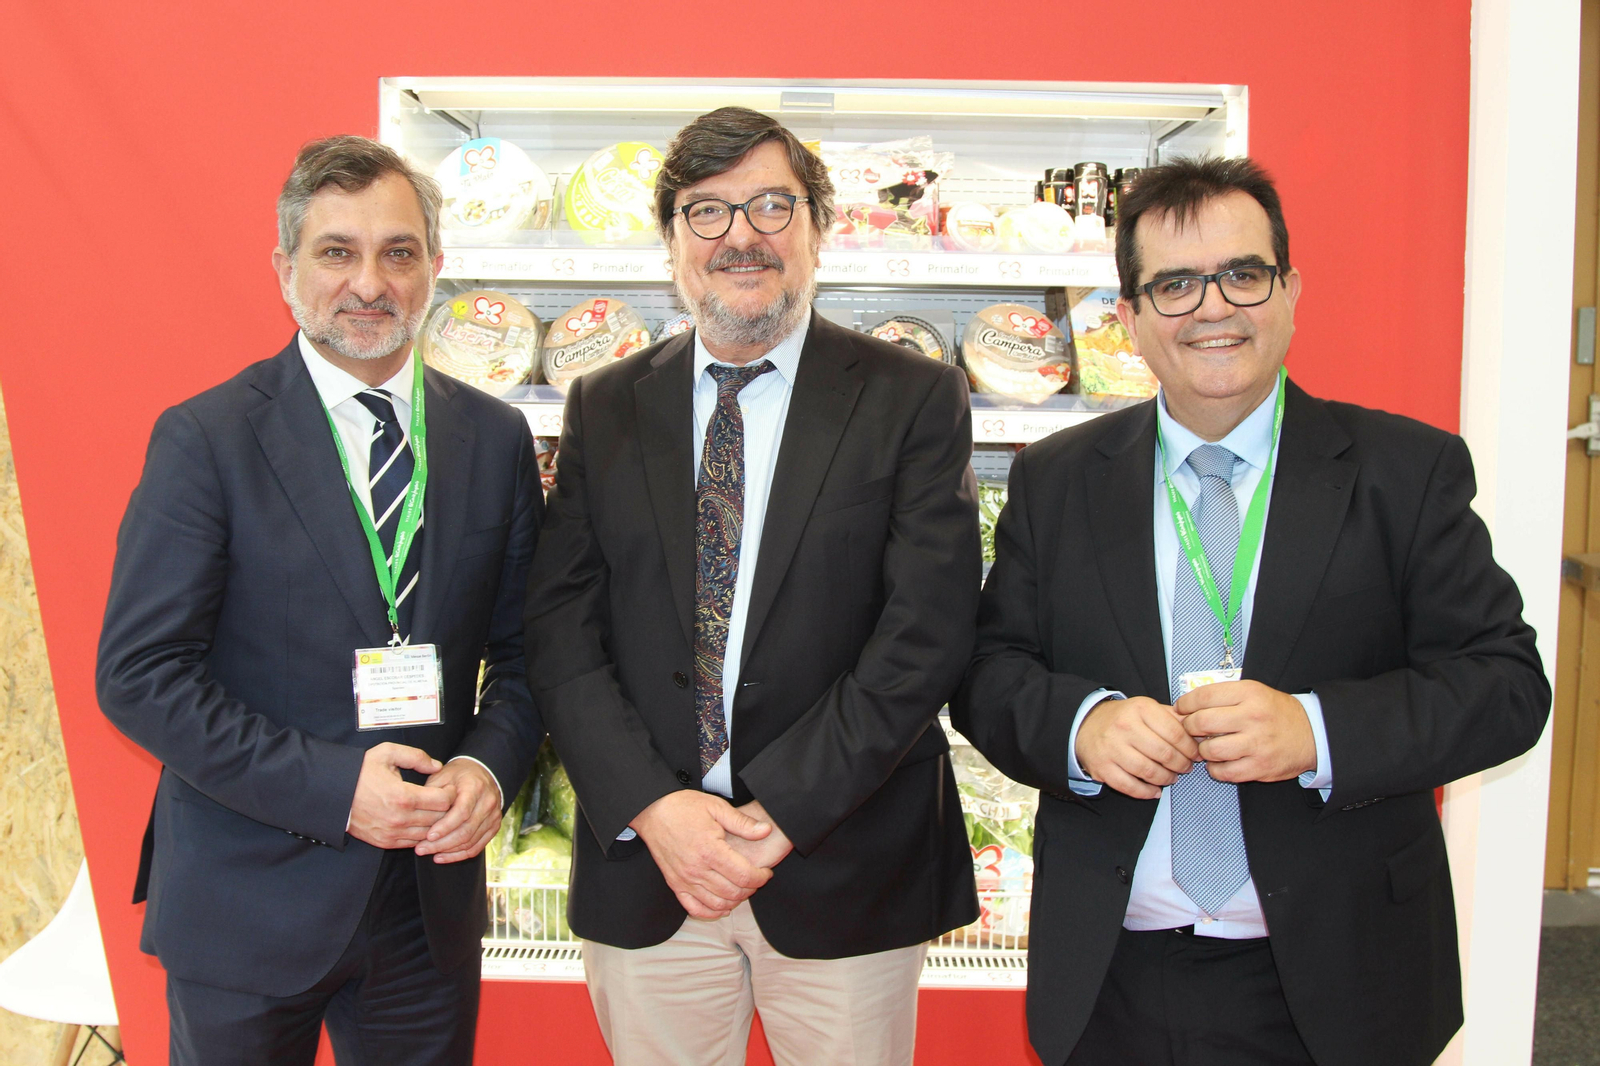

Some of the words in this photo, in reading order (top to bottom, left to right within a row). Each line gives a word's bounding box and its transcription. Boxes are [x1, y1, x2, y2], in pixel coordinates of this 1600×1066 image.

[482, 260, 532, 272] Primaflor
[592, 262, 645, 273] Primaflor
[928, 264, 980, 274] Primaflor
[1038, 266, 1090, 276] Primaflor
[442, 318, 493, 350] Ligera
[982, 330, 1042, 355] Campera
[554, 336, 610, 368] Campera
